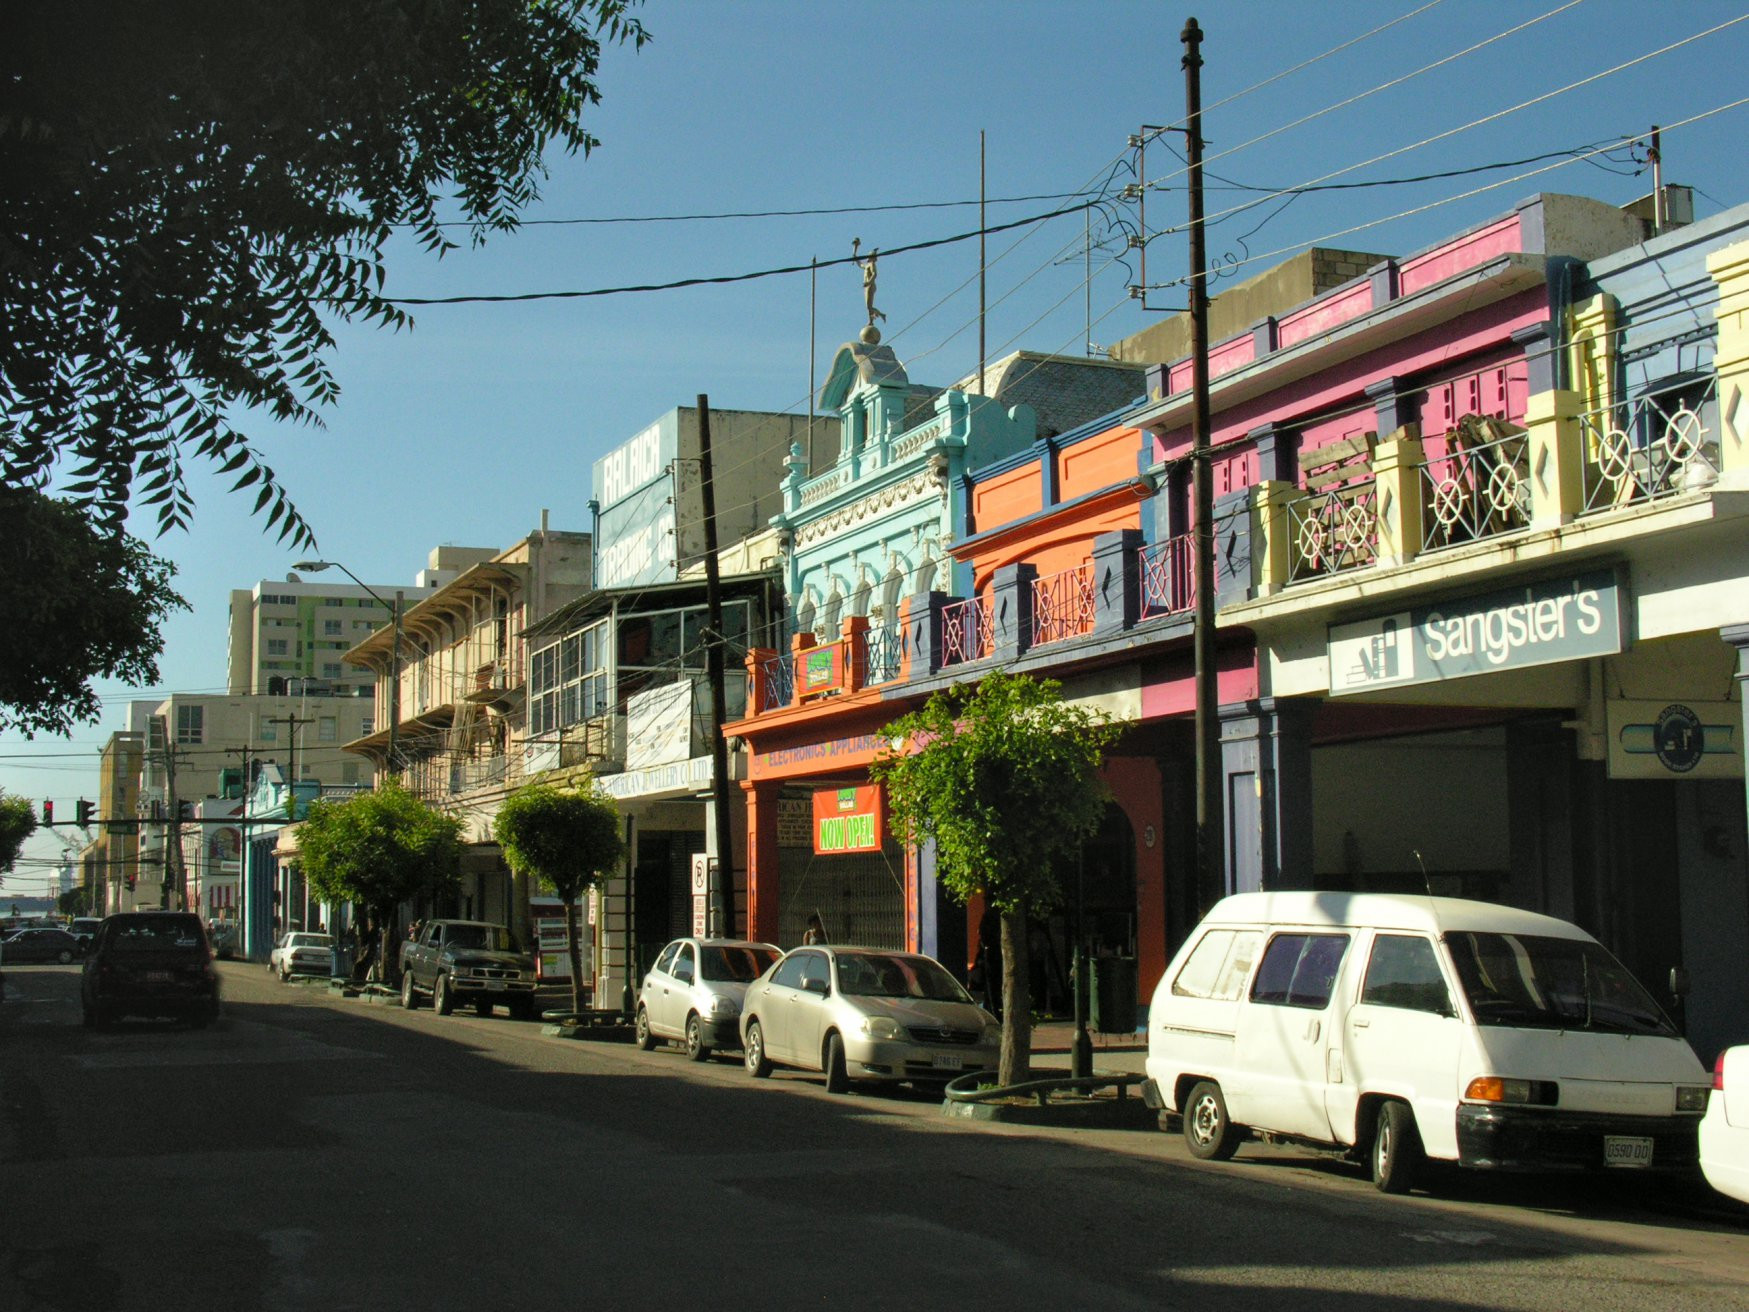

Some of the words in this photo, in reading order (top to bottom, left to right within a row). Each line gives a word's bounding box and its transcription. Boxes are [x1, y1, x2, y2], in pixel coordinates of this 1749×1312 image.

[1425, 580, 1601, 665] Sangster's
[768, 743, 827, 767] ELECTRONICS
[820, 816, 845, 851] NOW
[845, 813, 875, 849] OPEN!
